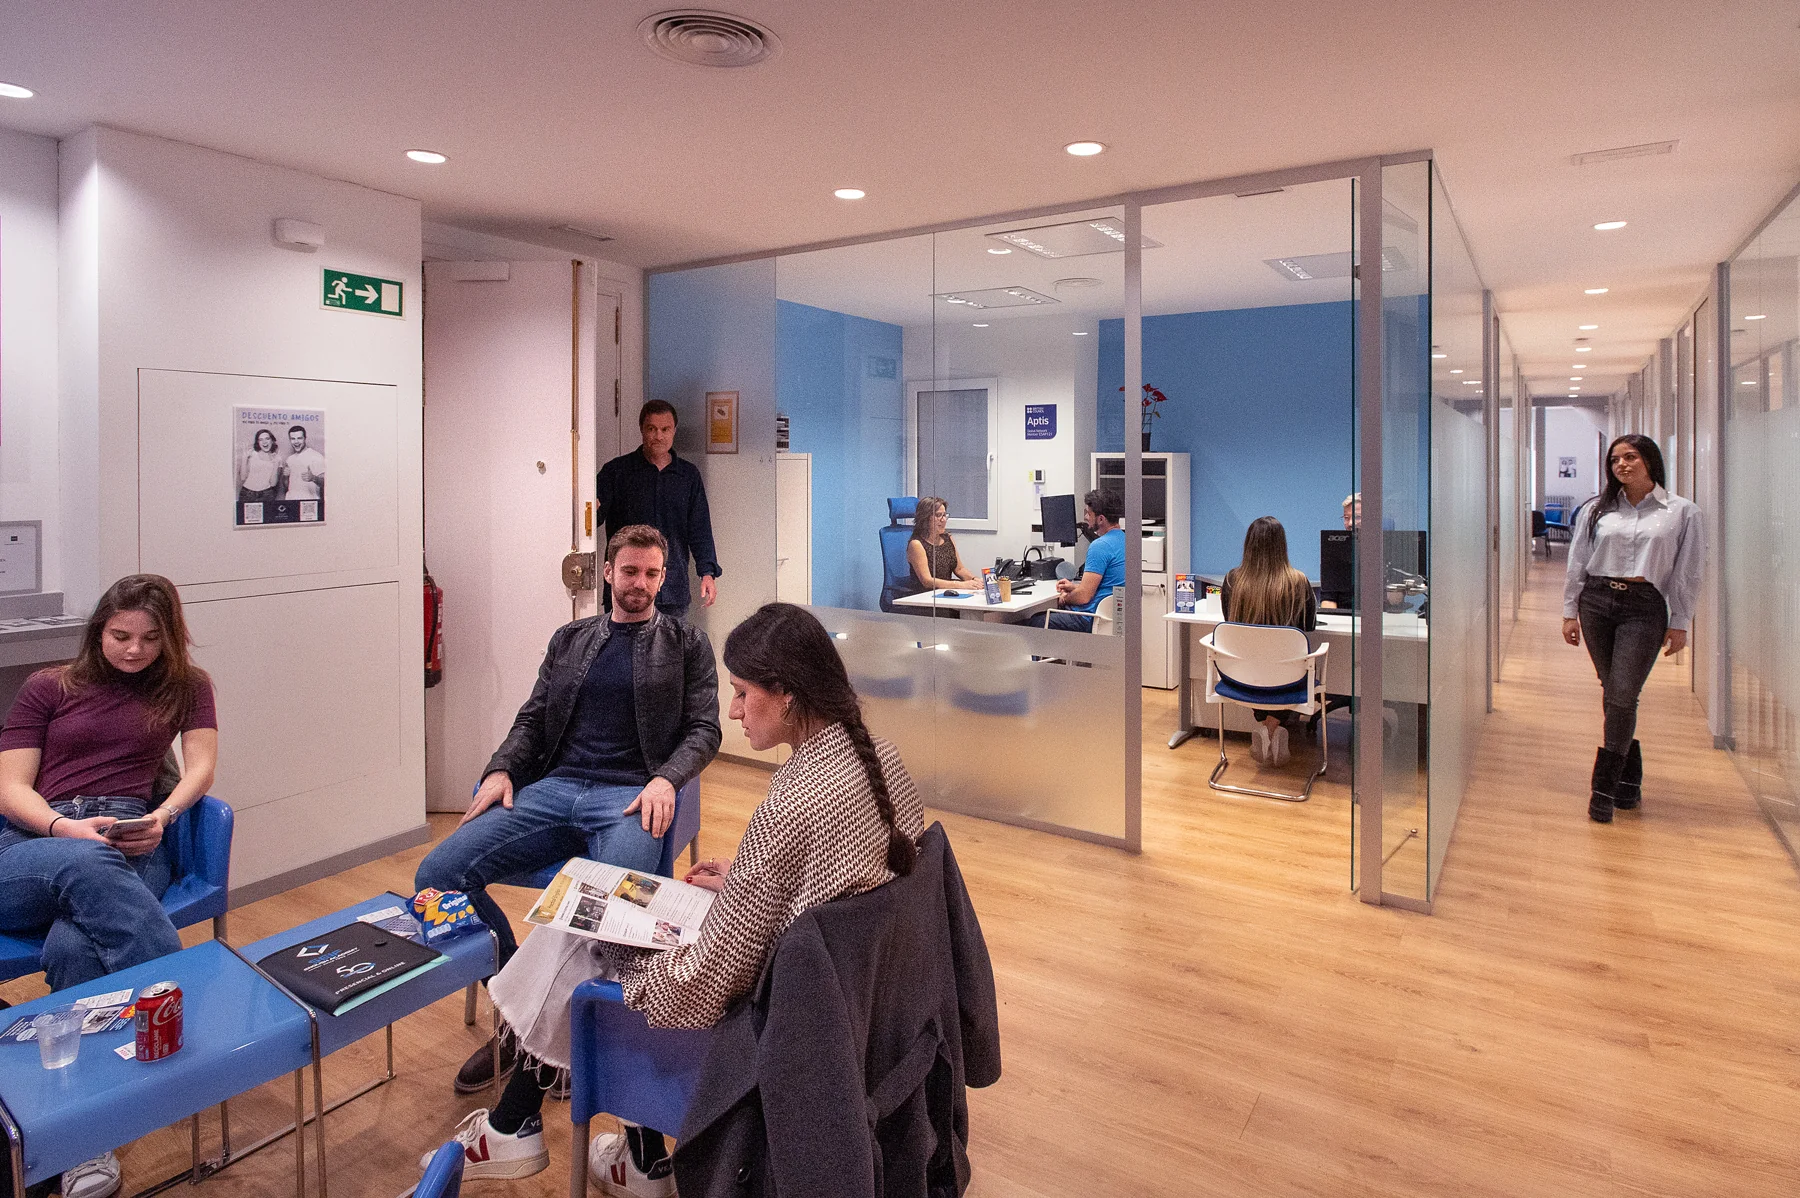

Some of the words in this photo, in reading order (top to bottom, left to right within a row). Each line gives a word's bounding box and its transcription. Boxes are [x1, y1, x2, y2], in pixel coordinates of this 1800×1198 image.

[242, 412, 287, 420] DESCUENTO
[1027, 416, 1049, 427] Aptis
[442, 894, 468, 910] Original
[335, 974, 376, 995] PRESENCIAL
[382, 961, 406, 973] ONLINE
